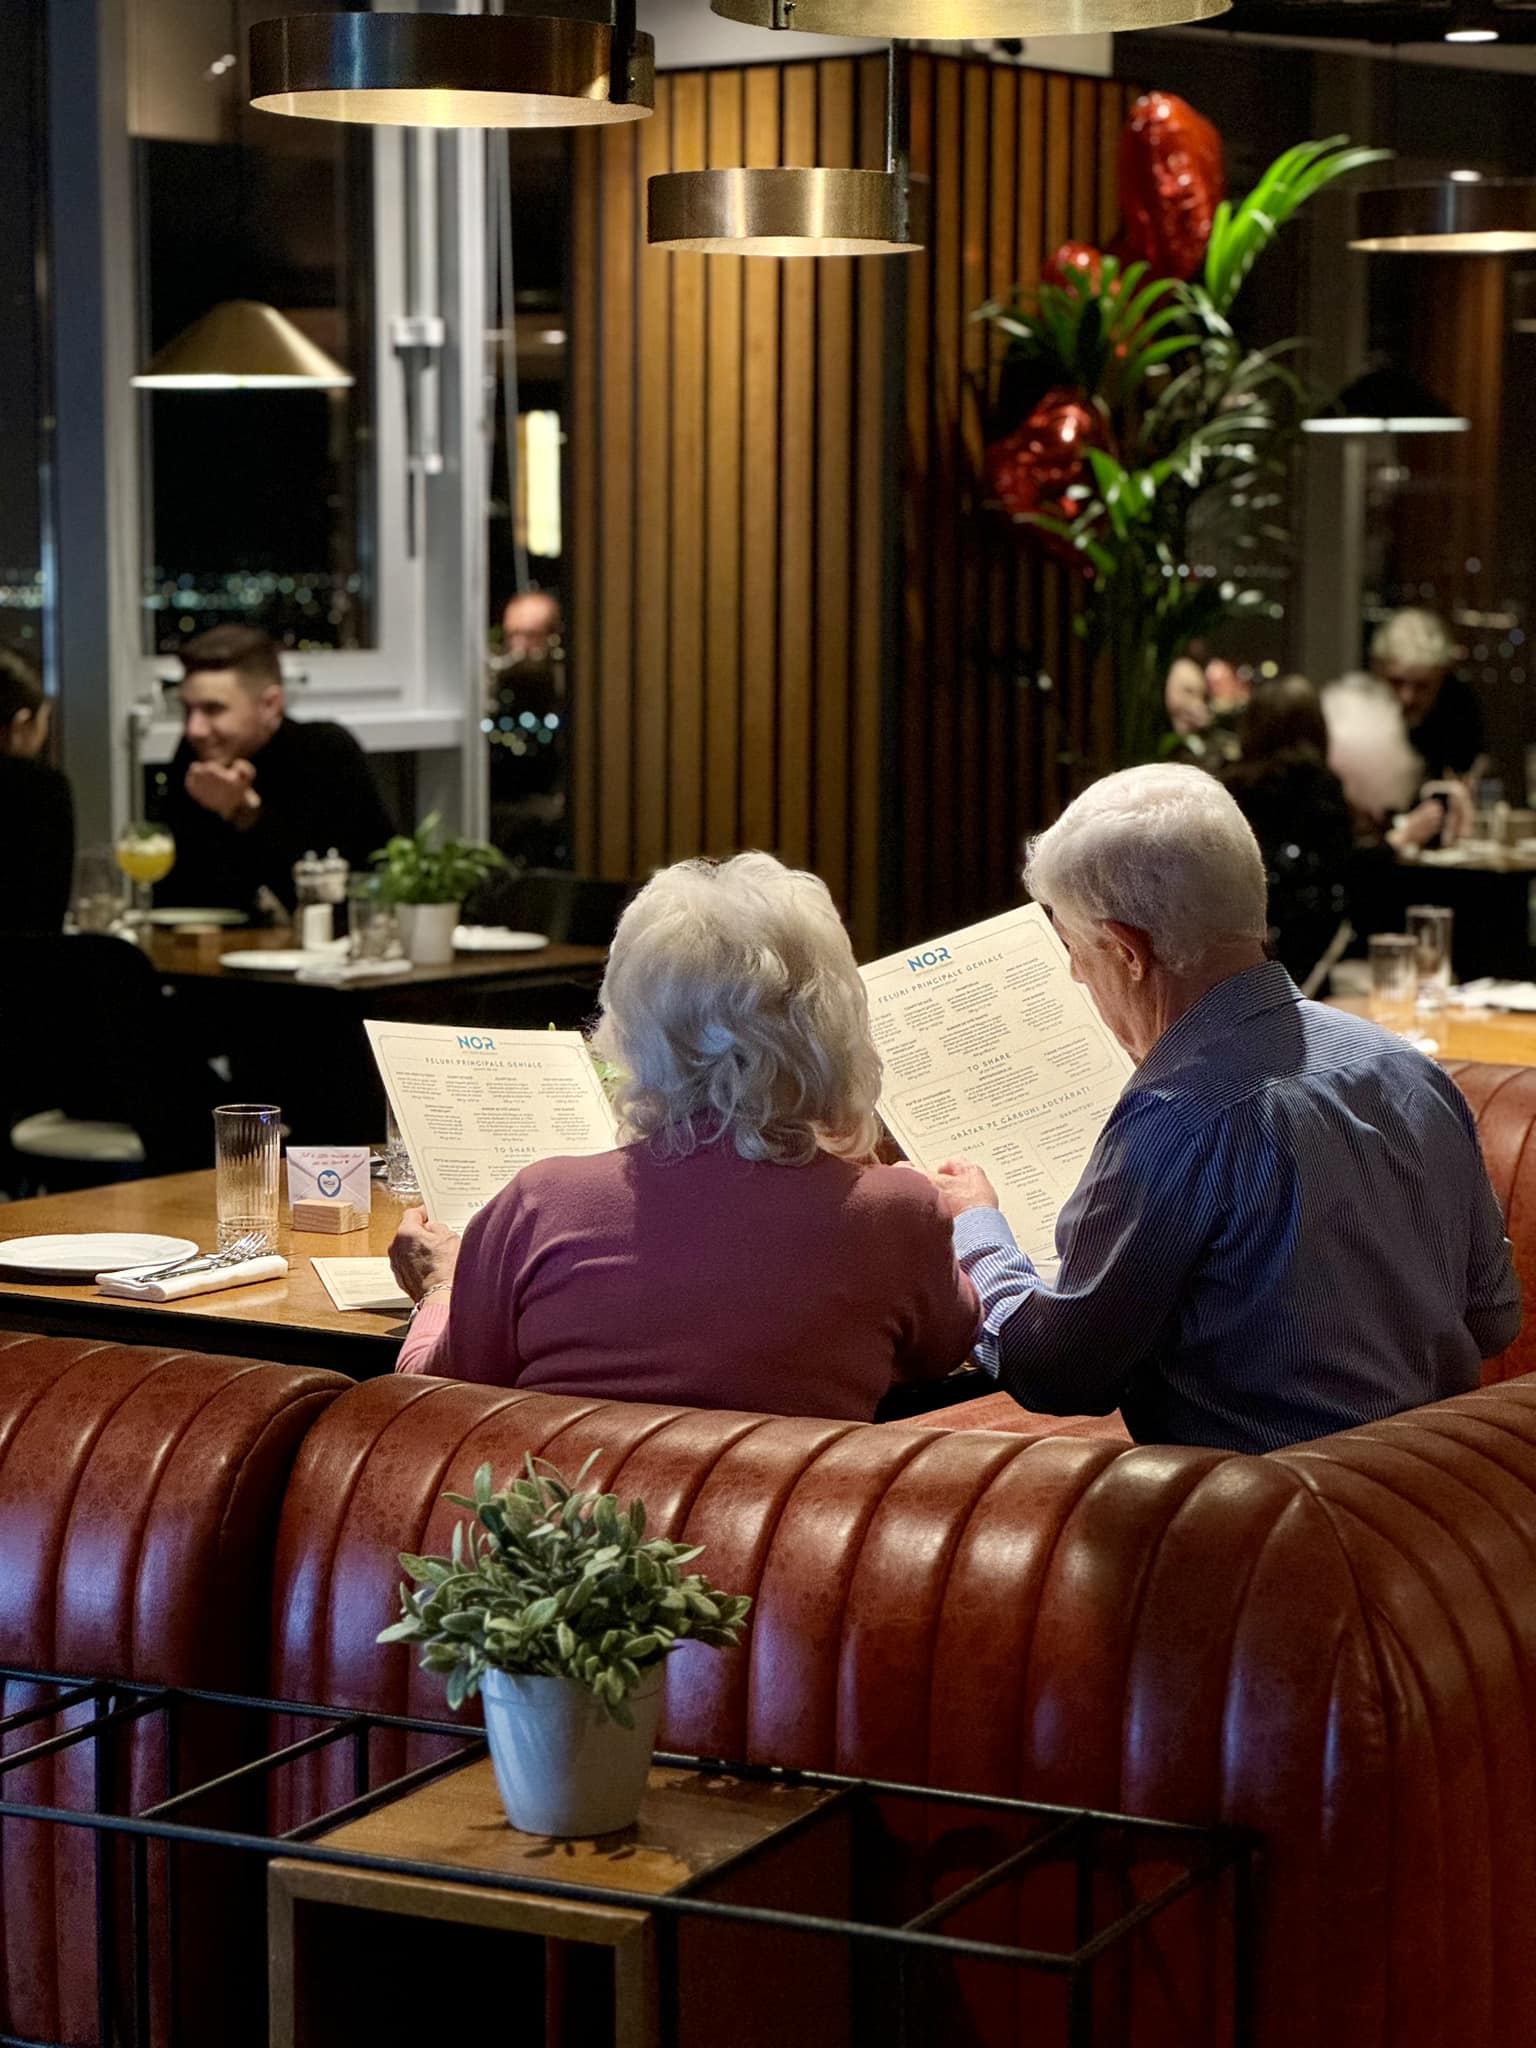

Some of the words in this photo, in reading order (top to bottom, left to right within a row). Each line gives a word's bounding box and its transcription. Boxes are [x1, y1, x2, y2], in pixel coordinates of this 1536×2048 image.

[907, 947, 952, 972] NOR
[878, 988, 909, 1004] FELURI
[911, 968, 963, 992] PRINCIPALE
[966, 952, 1004, 972] GENIALE
[456, 1035, 497, 1050] NOR
[455, 1058, 505, 1068] PRINCIPALE
[507, 1060, 543, 1069] GENIALE
[967, 1063, 980, 1073] TO
[982, 1052, 1012, 1068] SHARE
